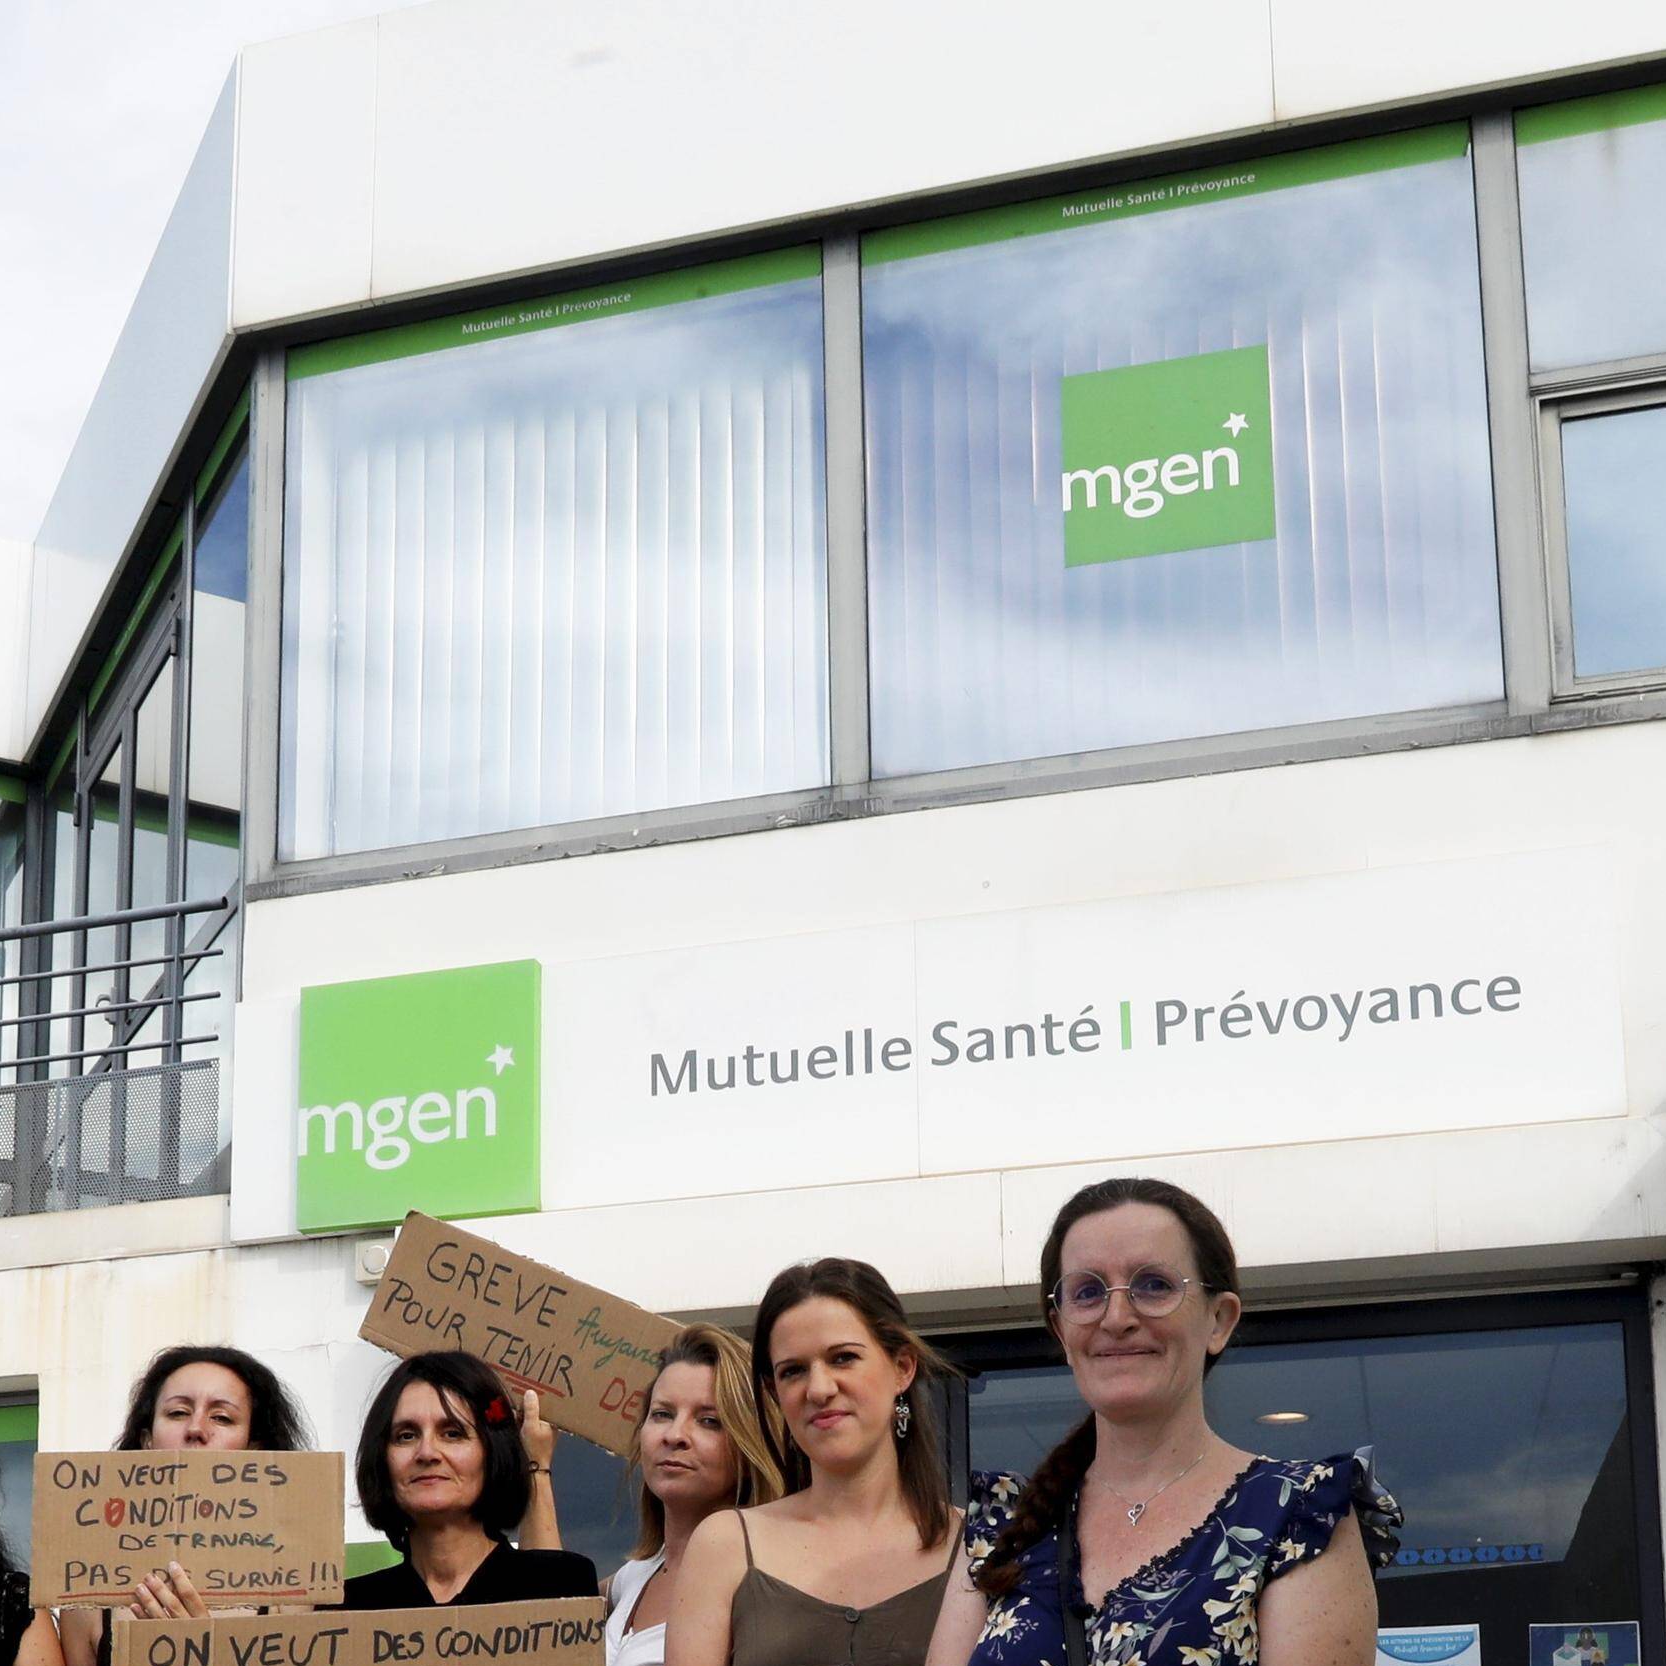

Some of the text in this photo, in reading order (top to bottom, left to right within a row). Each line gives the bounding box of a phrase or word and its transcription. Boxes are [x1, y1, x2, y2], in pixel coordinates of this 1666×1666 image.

[1062, 173, 1256, 218] Mutuelle Santé Prévoyance
[462, 292, 632, 334] Mutuelle Santé Prévoyance
[1062, 447, 1239, 518] mgen
[650, 1028, 912, 1096] Mutuelle
[931, 1006, 1101, 1067] Santé
[1155, 974, 1522, 1047] Prévoyance
[298, 1086, 496, 1170] mgen
[427, 1242, 567, 1328] GREVE
[383, 1278, 467, 1350] POUR
[53, 1460, 287, 1489] ON VEUT DES
[119, 1534, 156, 1551] DE
[65, 1561, 131, 1592] PAS
[373, 1629, 424, 1663] DES
